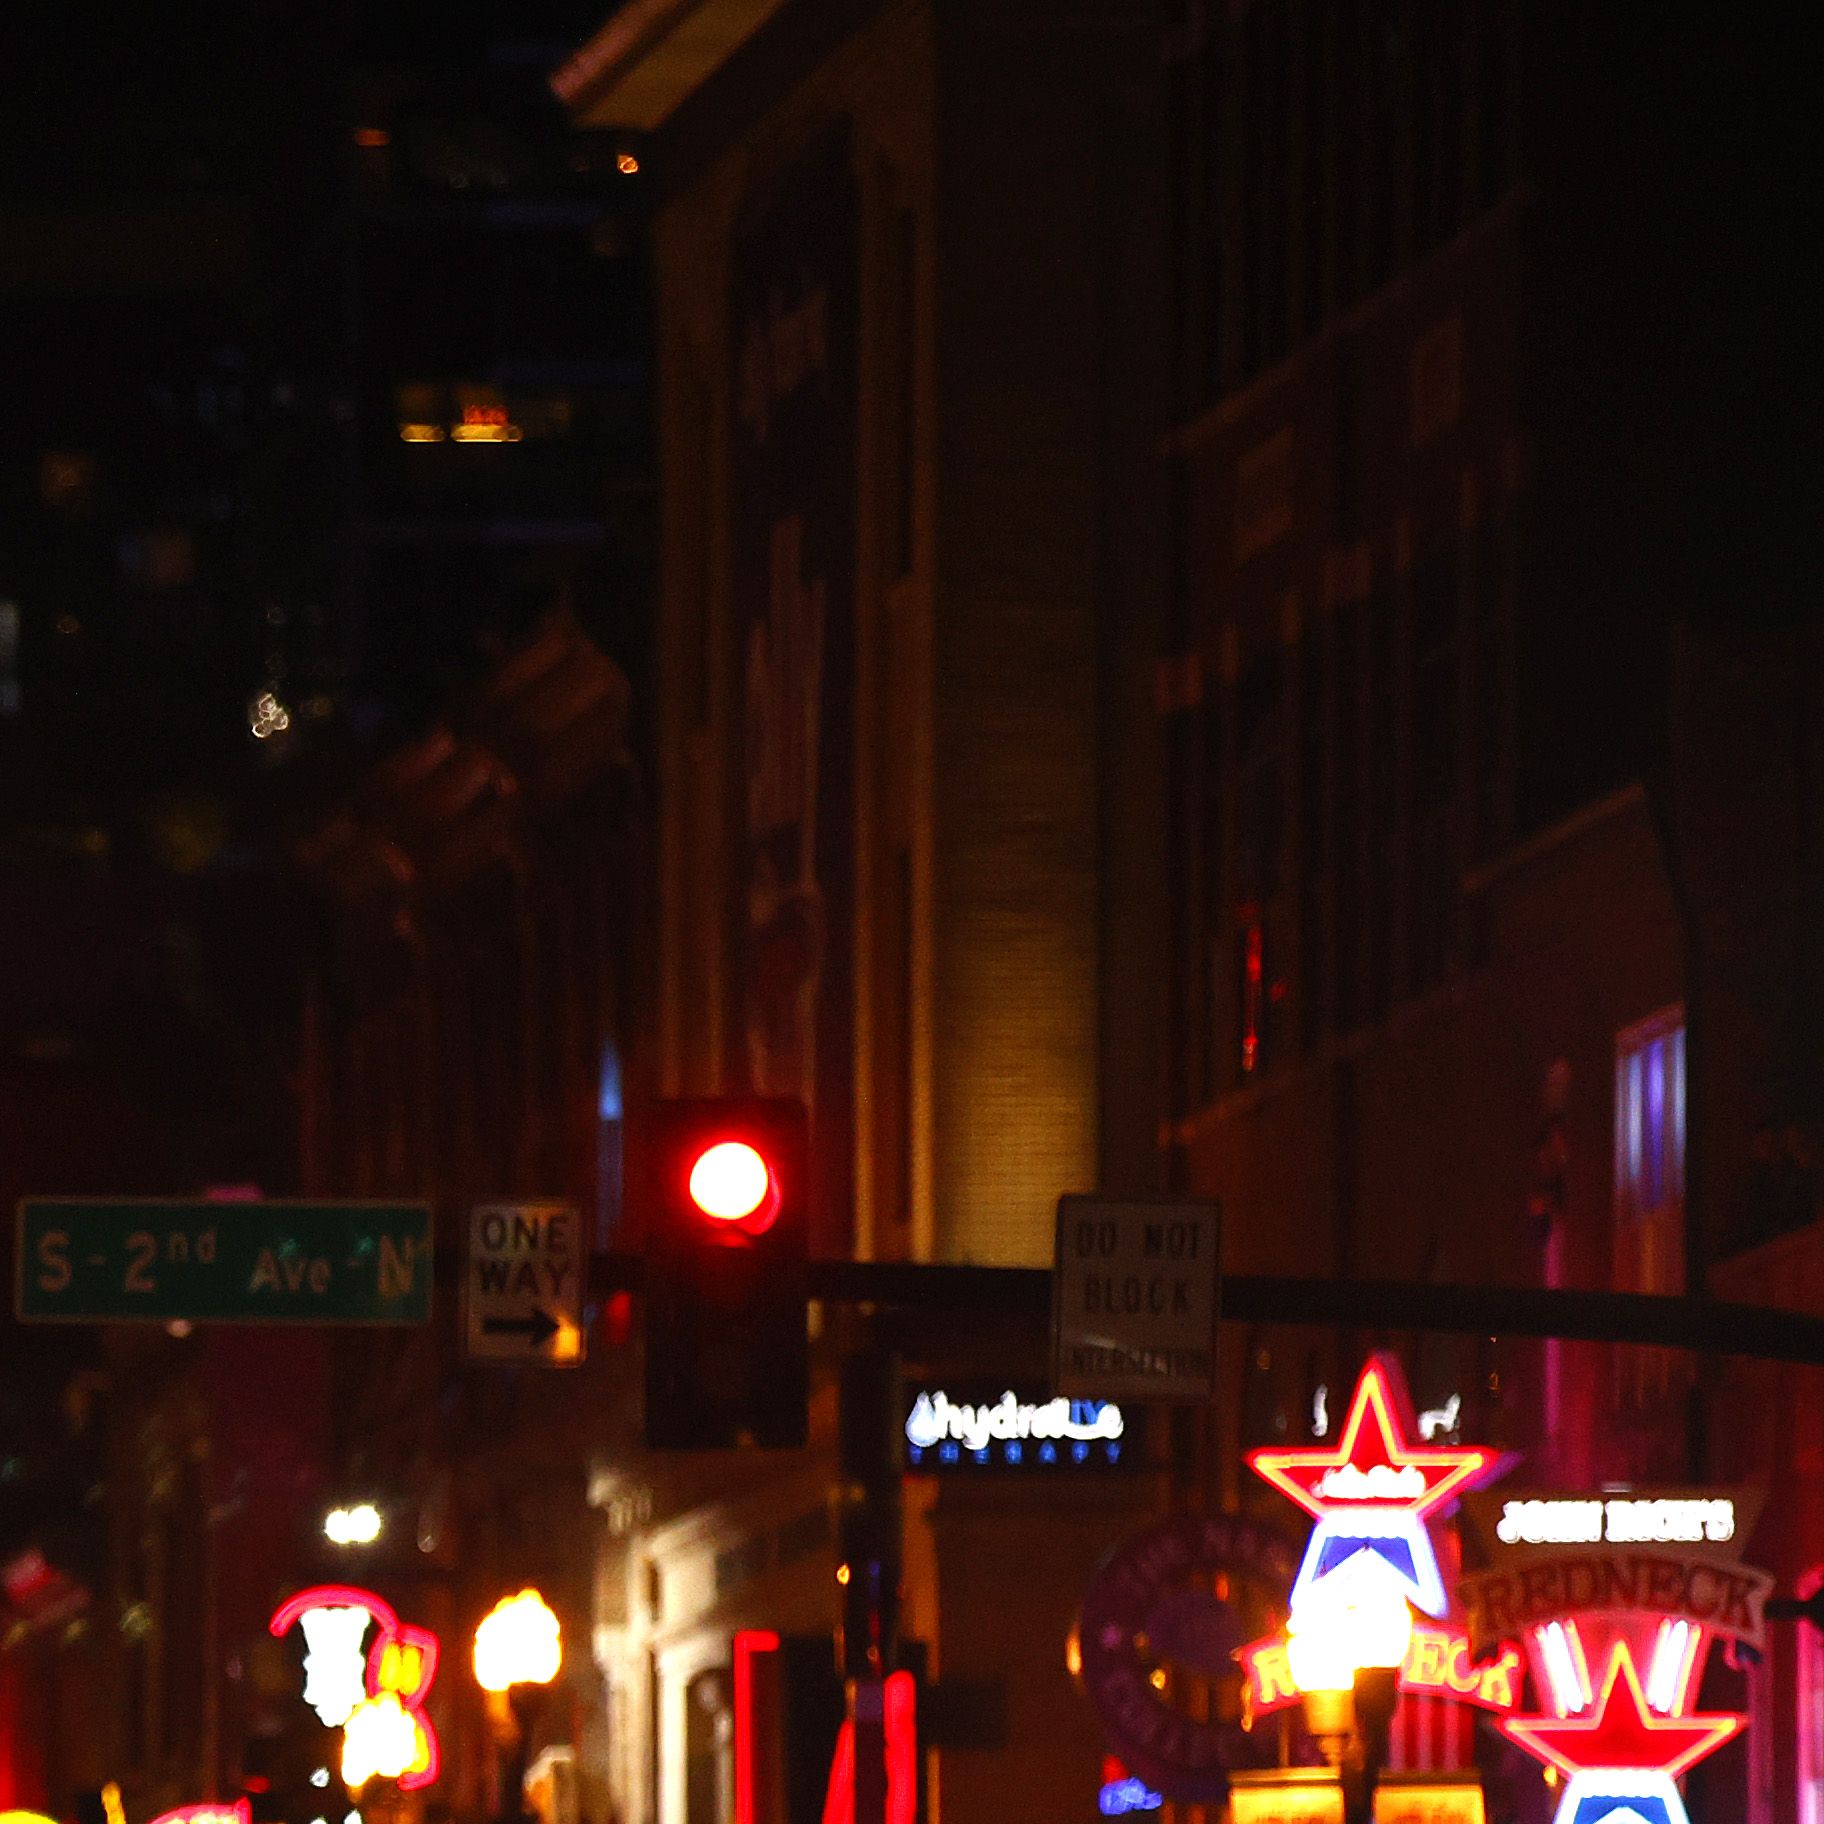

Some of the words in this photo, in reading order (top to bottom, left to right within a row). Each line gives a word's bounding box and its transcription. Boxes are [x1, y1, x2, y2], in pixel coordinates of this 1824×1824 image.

[479, 1215, 568, 1251] ONE
[1076, 1222, 1119, 1259] DO
[1145, 1222, 1200, 1260] NOT
[248, 1247, 332, 1295] Ave
[478, 1259, 572, 1296] WAY
[1084, 1276, 1192, 1314] BLOCK
[1478, 1554, 1762, 1636] REDNECK
[1253, 1632, 1515, 1706] RECK
